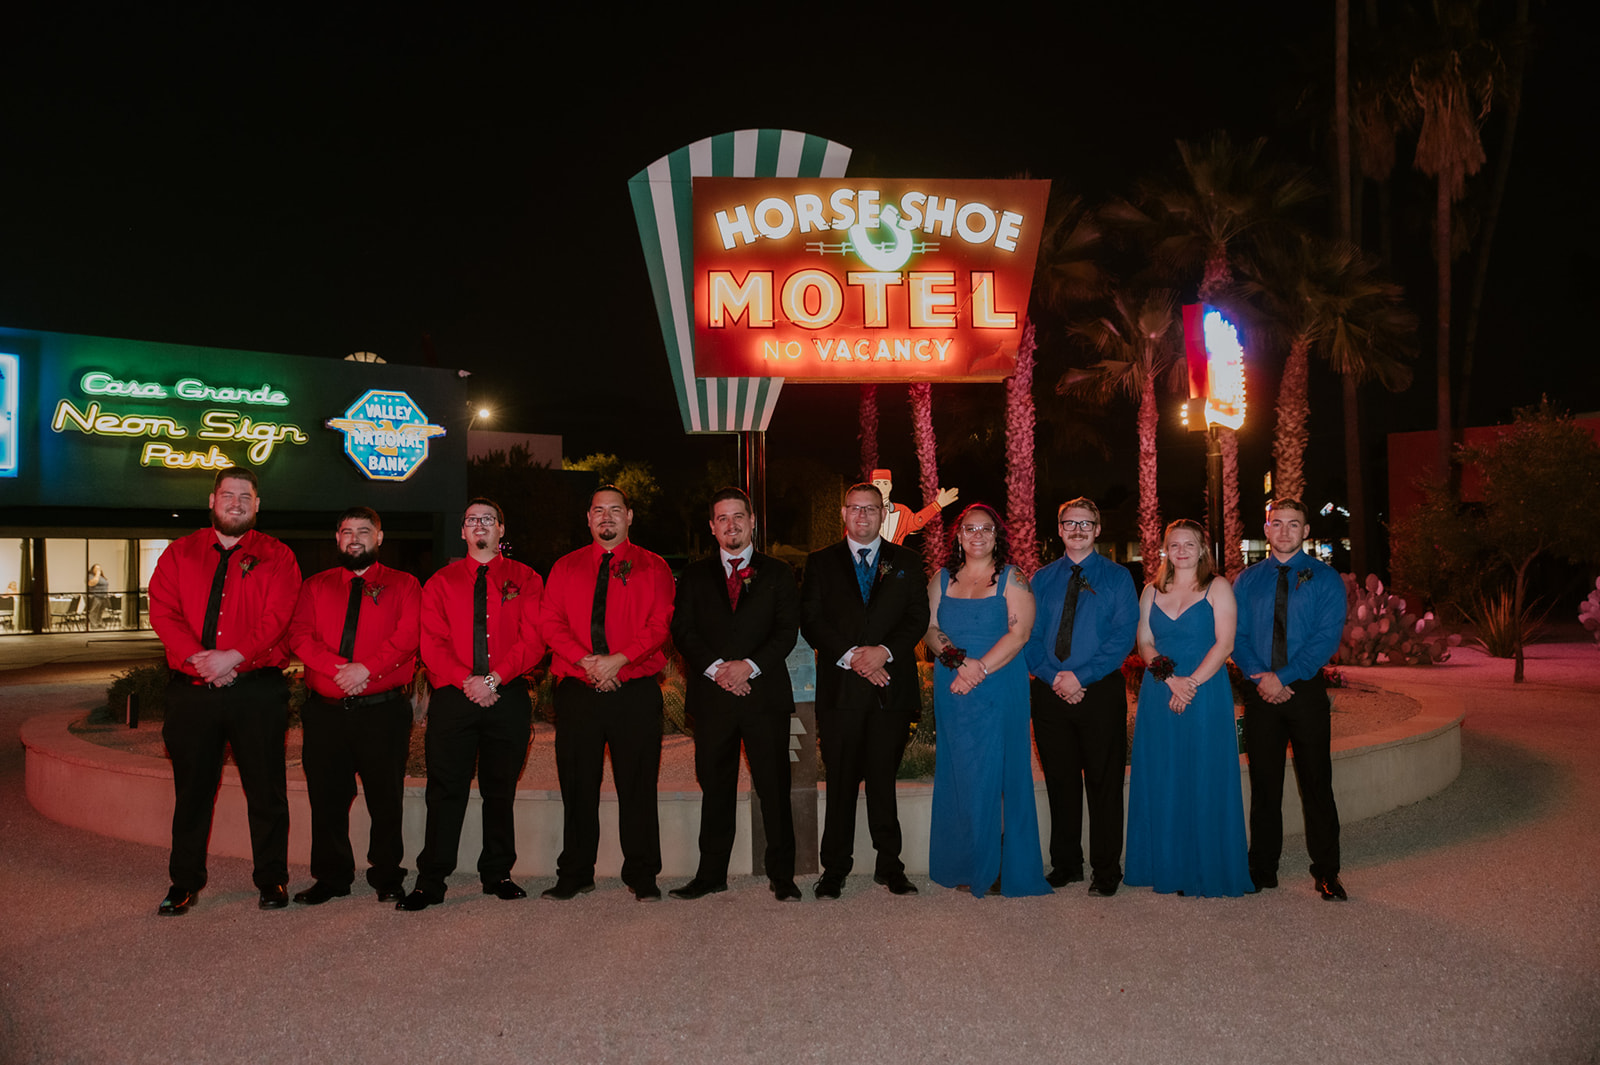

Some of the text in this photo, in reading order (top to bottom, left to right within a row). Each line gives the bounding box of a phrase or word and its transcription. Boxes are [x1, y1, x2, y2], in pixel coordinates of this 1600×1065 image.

[714, 187, 1025, 253] HORSE SHOE
[707, 269, 1018, 329] MOTEL
[763, 337, 955, 362] NO VACANCY
[81, 371, 290, 406] Casa Grande
[365, 403, 412, 420] VALLEY
[51, 399, 309, 464] Neon Sign
[353, 430, 423, 449] NATIONAL
[140, 444, 235, 470] Park
[368, 455, 409, 472] BANK
